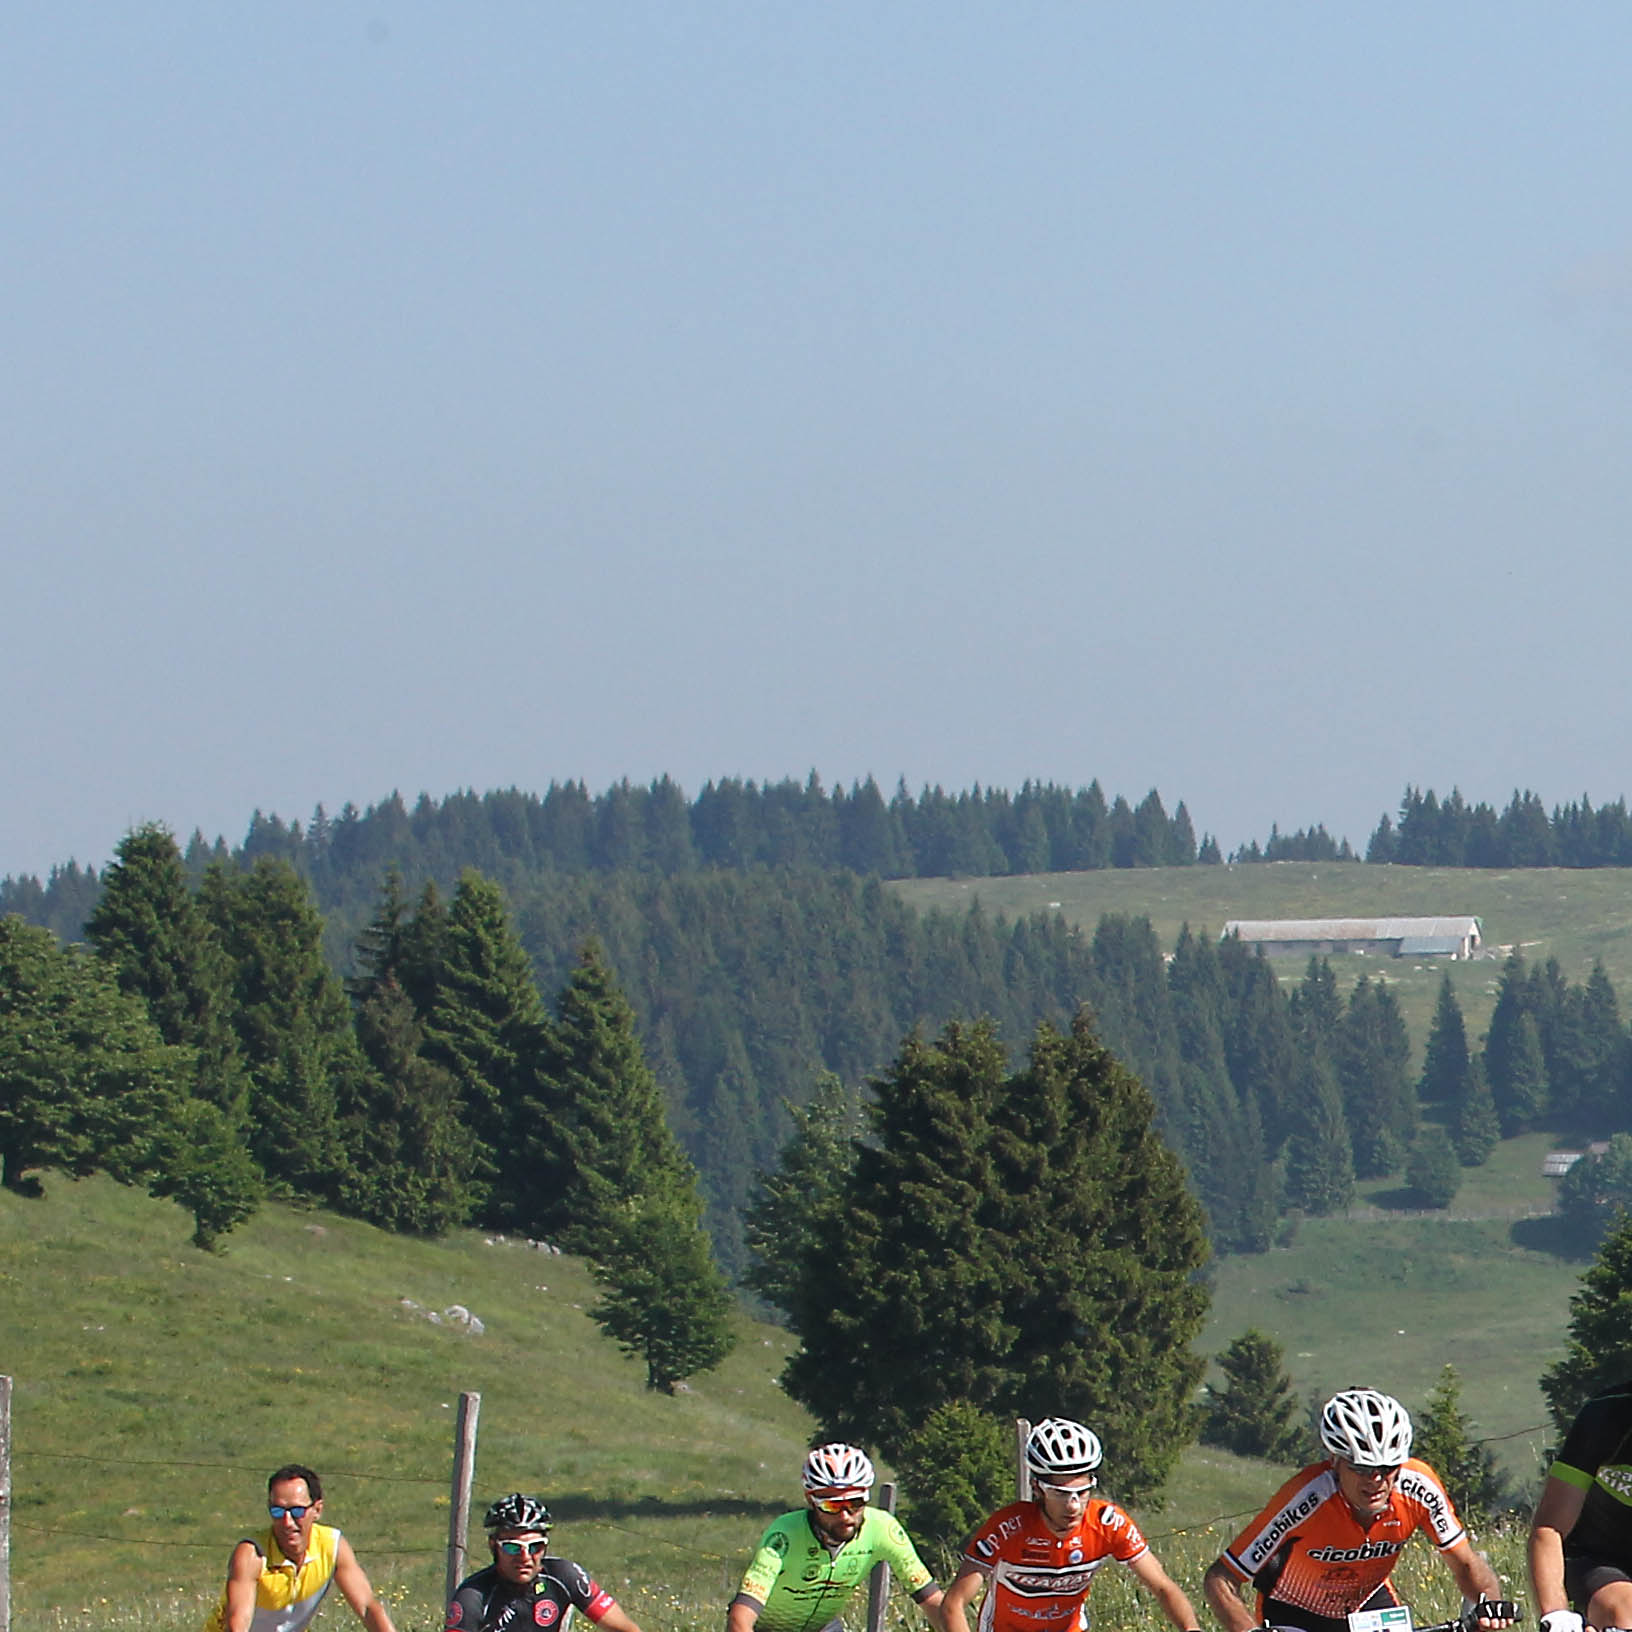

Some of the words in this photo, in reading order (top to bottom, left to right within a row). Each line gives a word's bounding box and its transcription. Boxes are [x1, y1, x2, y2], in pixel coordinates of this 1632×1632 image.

[1251, 1491, 1319, 1565] cicobikes
[1401, 1477, 1450, 1535] cicobikes
[976, 1534, 1000, 1557] Up
[998, 1515, 1023, 1541] per
